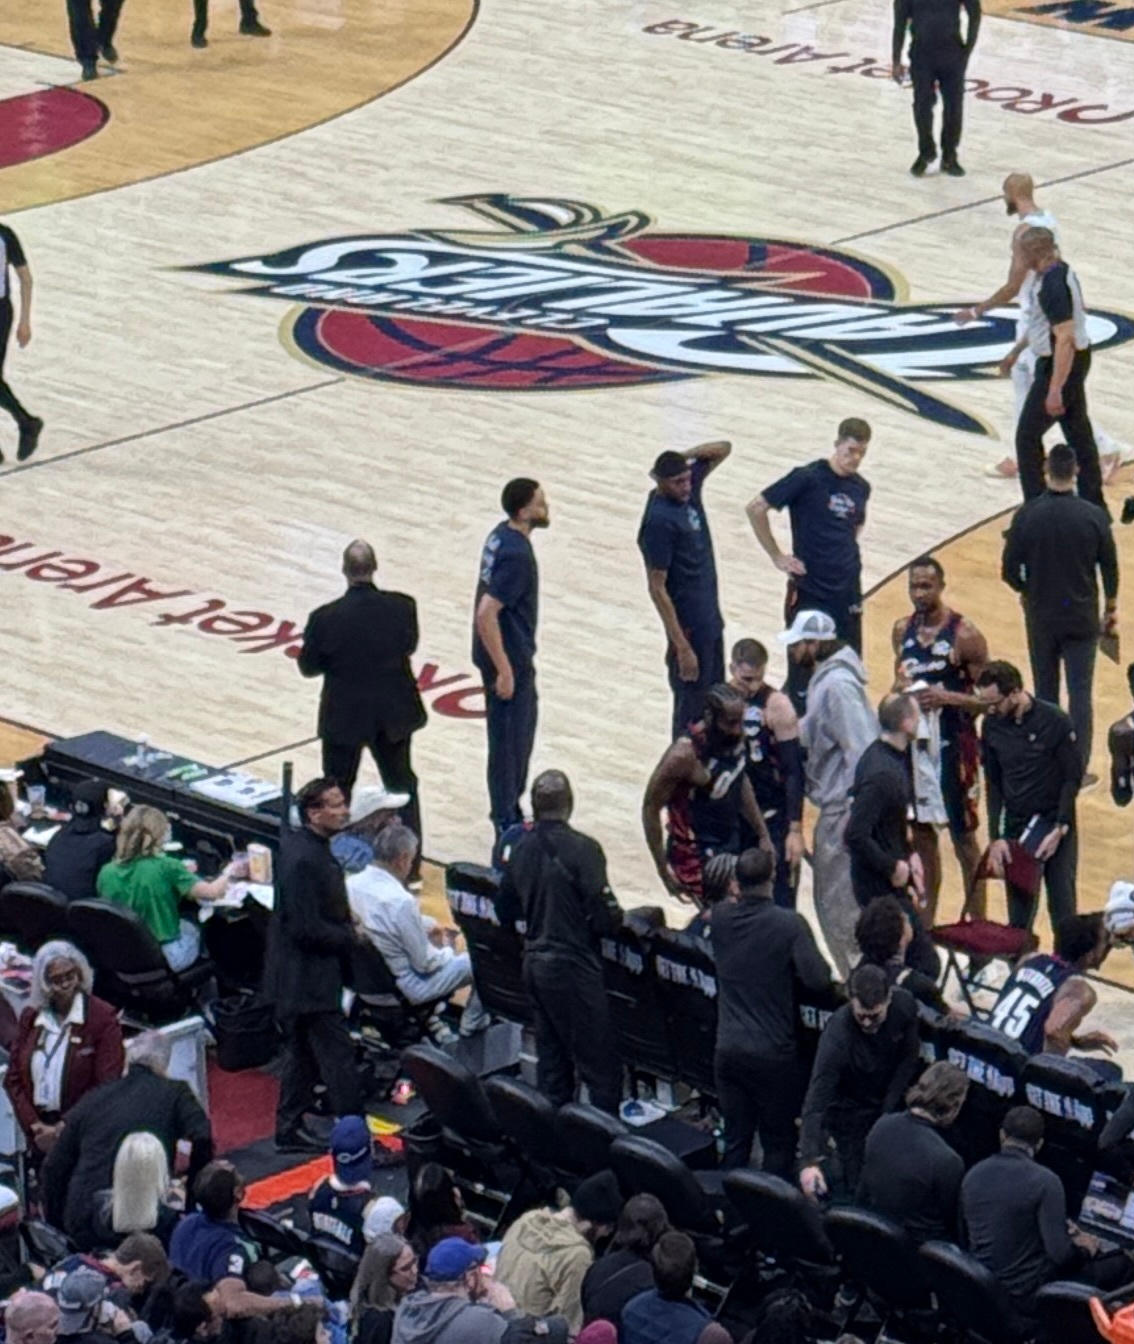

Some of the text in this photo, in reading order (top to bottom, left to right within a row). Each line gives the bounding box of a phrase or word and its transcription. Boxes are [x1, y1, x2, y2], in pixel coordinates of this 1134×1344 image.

[642, 18, 1075, 113] Rocet Arena
[0, 535, 197, 610] Aren
[991, 987, 1040, 1040] 45
